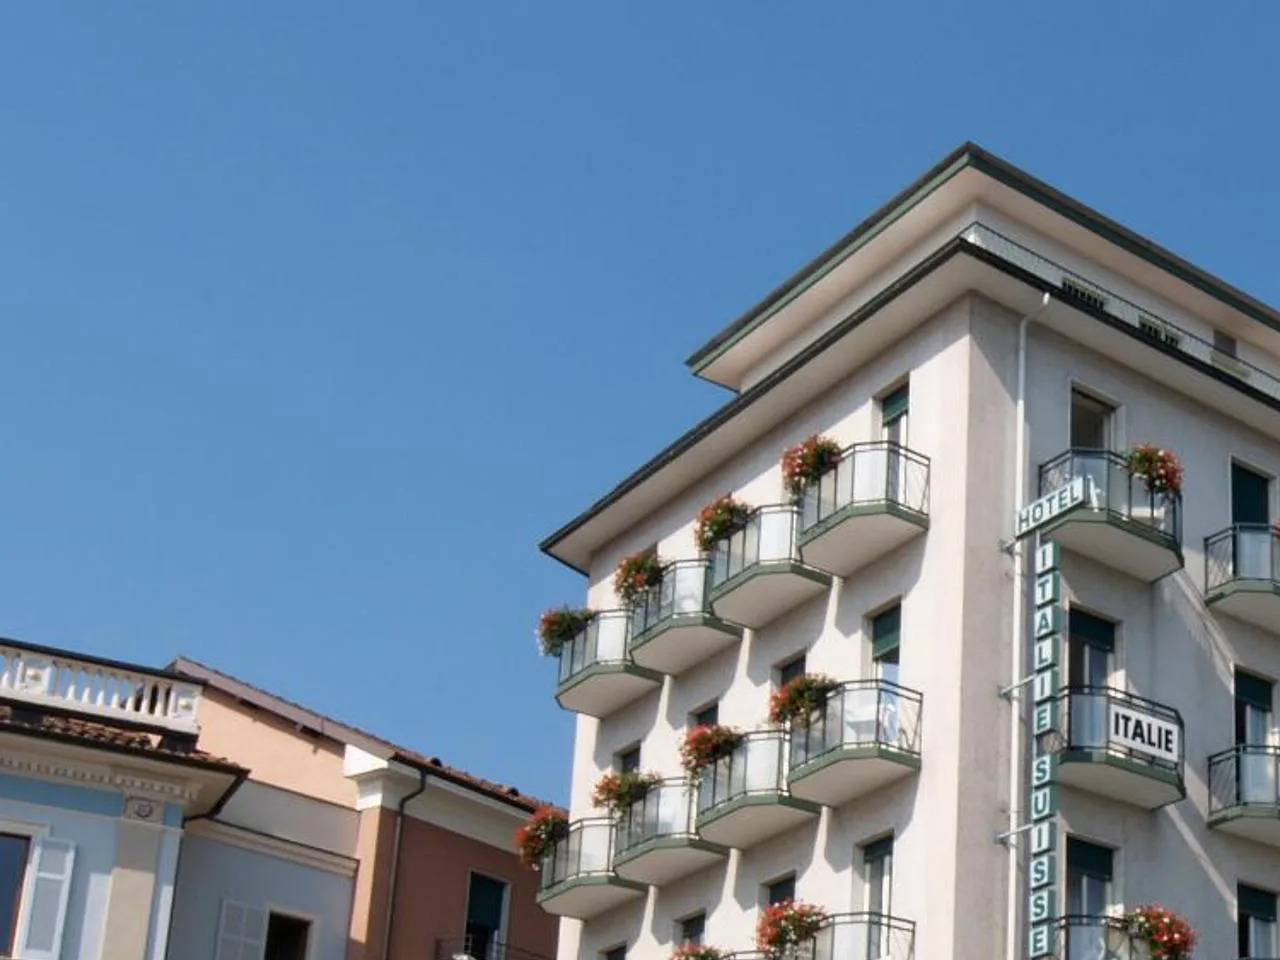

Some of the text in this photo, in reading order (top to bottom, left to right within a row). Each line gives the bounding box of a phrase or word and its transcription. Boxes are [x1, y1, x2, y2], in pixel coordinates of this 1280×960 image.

[1018, 484, 1081, 533] HOTEL
[1032, 549, 1051, 952] ITALIE SUISSE
[1113, 711, 1174, 754] ITALIE
